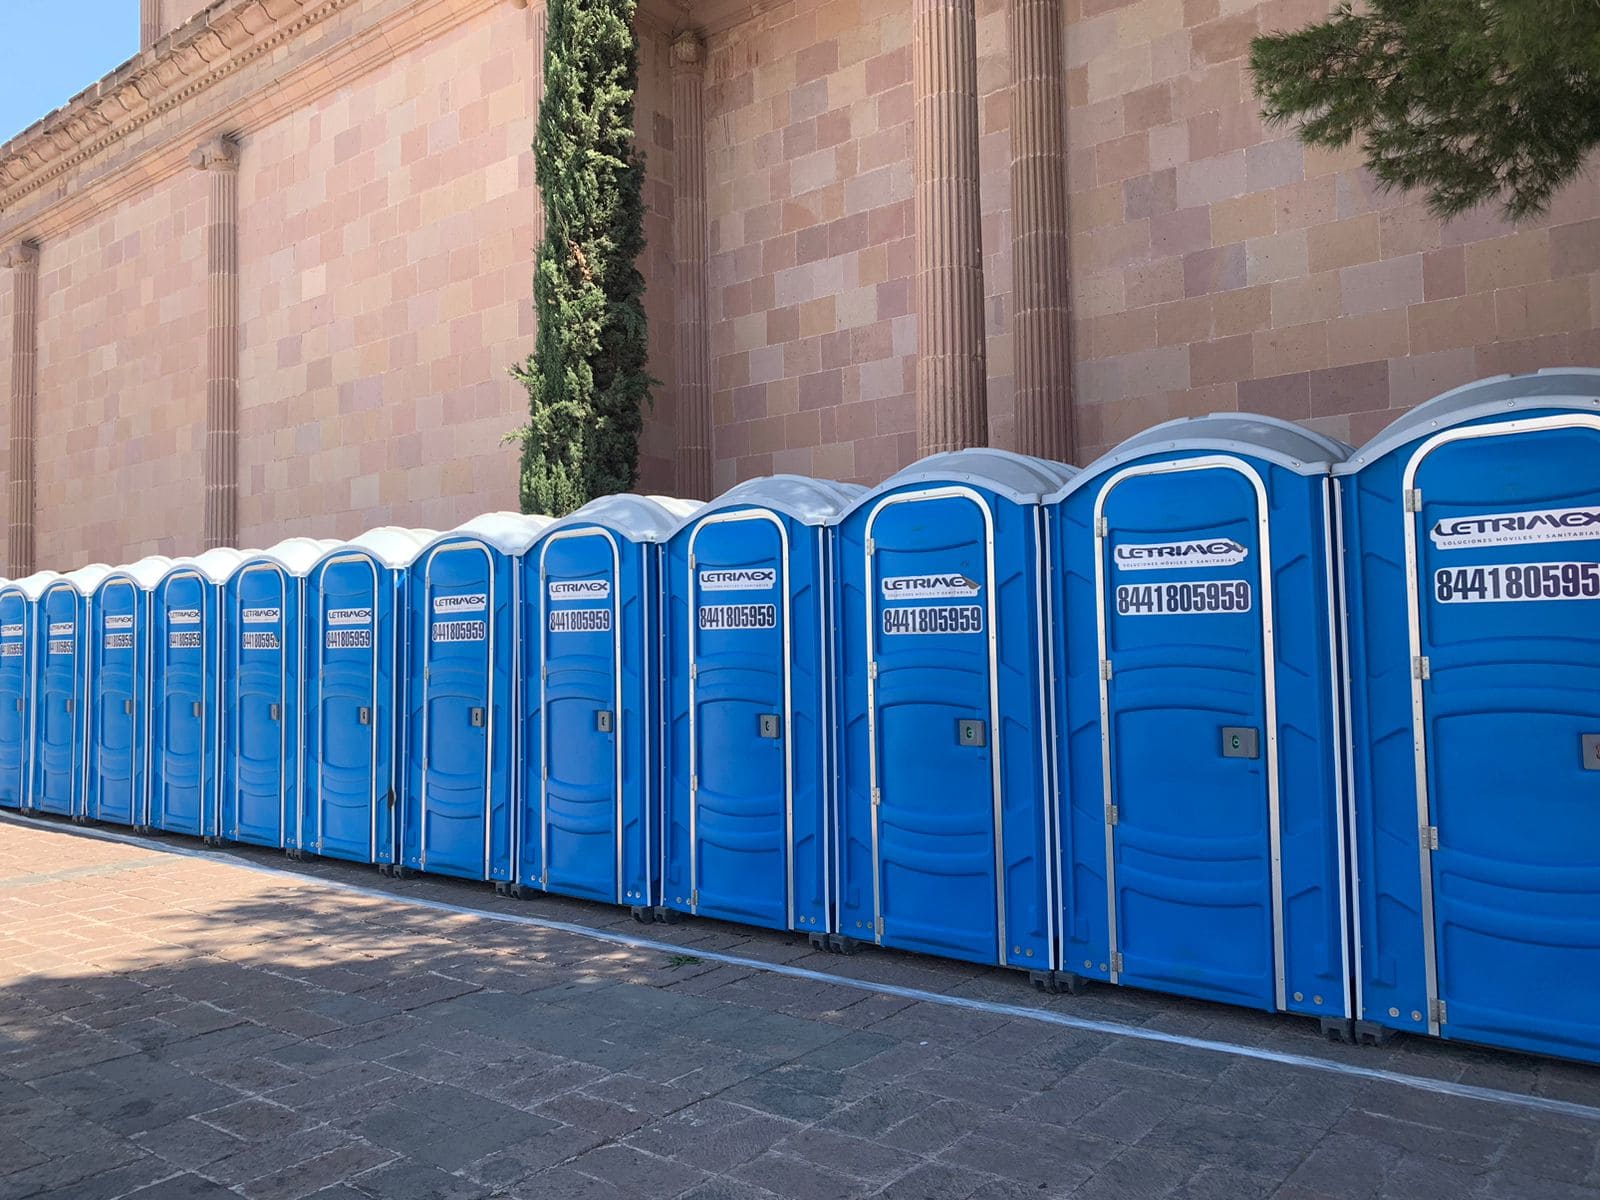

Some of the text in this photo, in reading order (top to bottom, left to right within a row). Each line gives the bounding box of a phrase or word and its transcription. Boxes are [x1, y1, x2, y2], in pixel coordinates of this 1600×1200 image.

[1435, 512, 1600, 536] LETRIMEX
[1442, 538, 1492, 546] SOLUCIONES
[701, 571, 773, 583] LETRIMEX
[884, 576, 968, 590] LETRIME
[1437, 564, 1600, 601] 844180595
[551, 582, 608, 593] LETRIMEX
[435, 596, 485, 606] LETRIMEX
[1118, 582, 1249, 613] 8441805959
[329, 610, 371, 618] LETRIMEX
[551, 610, 610, 630] 8441805959
[700, 605, 775, 628] 8441805959
[884, 607, 981, 633] 8441805959
